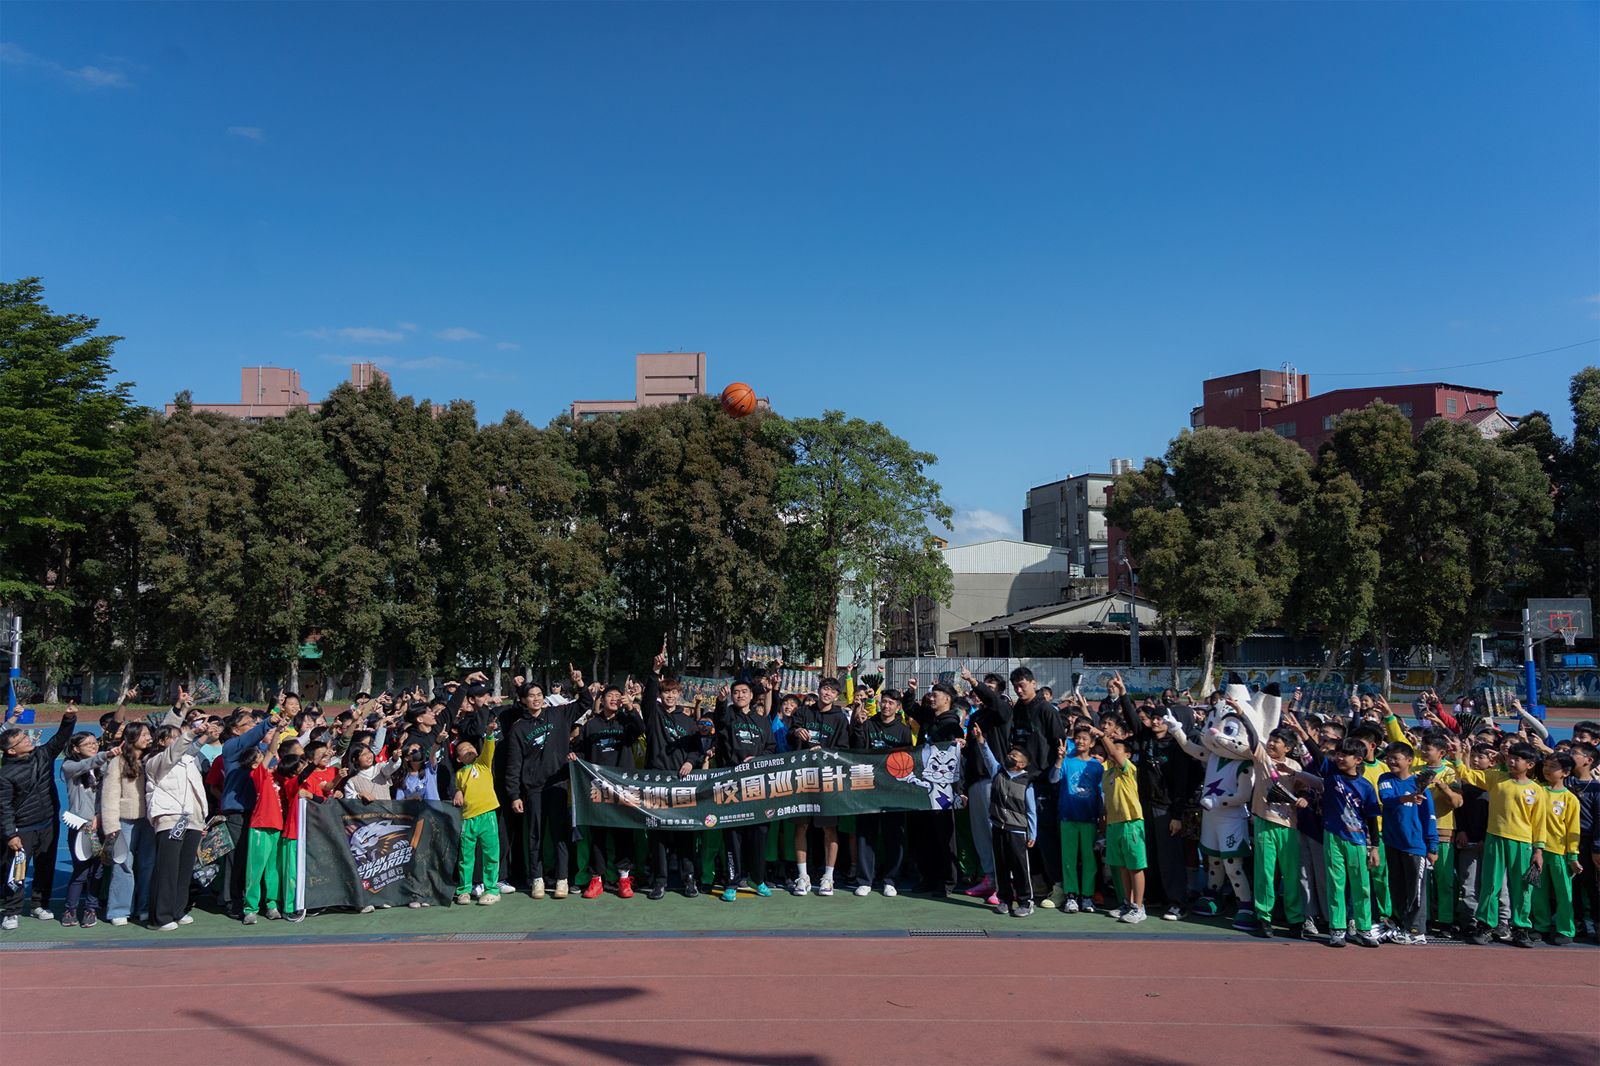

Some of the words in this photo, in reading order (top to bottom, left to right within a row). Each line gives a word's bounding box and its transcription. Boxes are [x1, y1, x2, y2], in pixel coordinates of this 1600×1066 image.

[680, 774, 707, 782] AOYUAN
[734, 763, 750, 773] BEER
[753, 757, 785, 769] LEOPARDS
[712, 763, 875, 806] 校園巡迴計畫
[357, 855, 387, 872] AIWAN
[387, 846, 413, 861] BEER
[358, 853, 413, 880] EOPARDS
